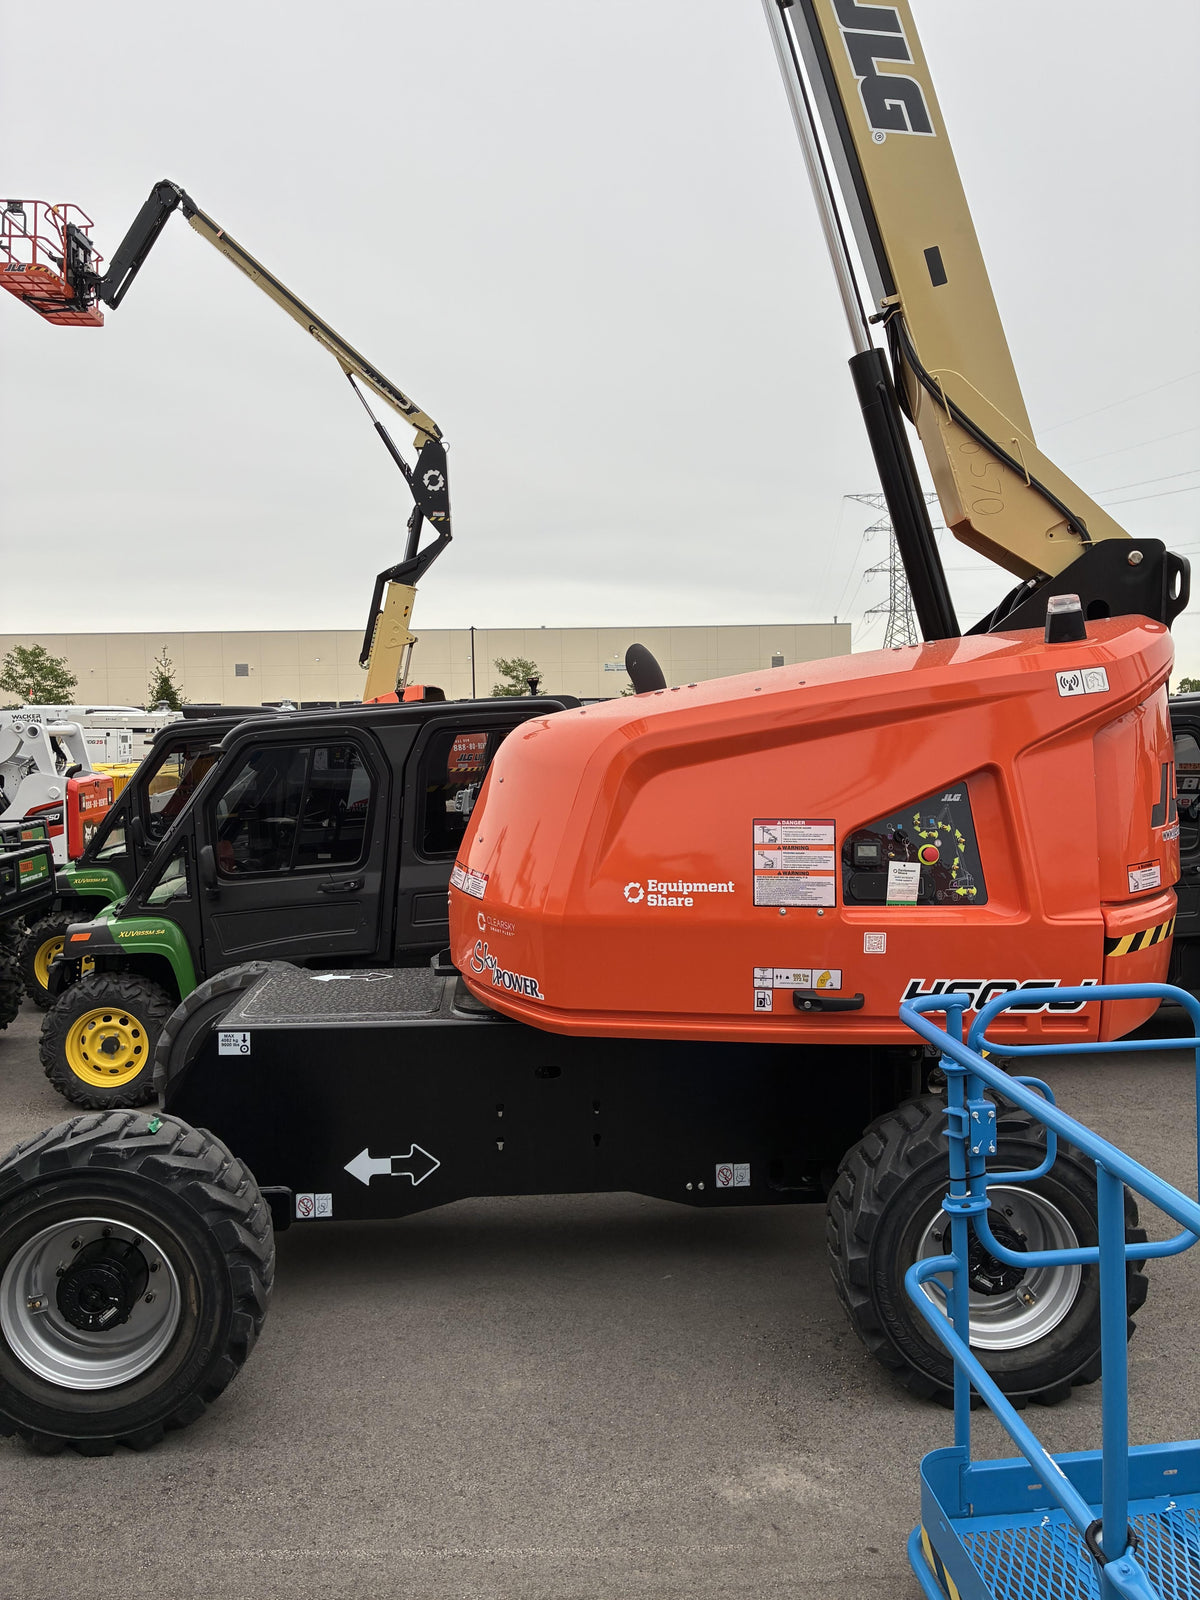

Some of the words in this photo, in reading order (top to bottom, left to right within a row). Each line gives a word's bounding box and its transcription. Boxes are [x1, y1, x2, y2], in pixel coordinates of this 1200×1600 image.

[829, 0, 937, 138] JLG
[3, 263, 27, 273] JLG
[455, 753, 474, 763] JLG
[941, 793, 962, 802] JLG
[647, 879, 736, 895] Equipment
[647, 893, 695, 907] Share
[486, 915, 516, 932] CLEARSKY
[469, 939, 499, 986] Sky
[492, 967, 541, 999] POWER
